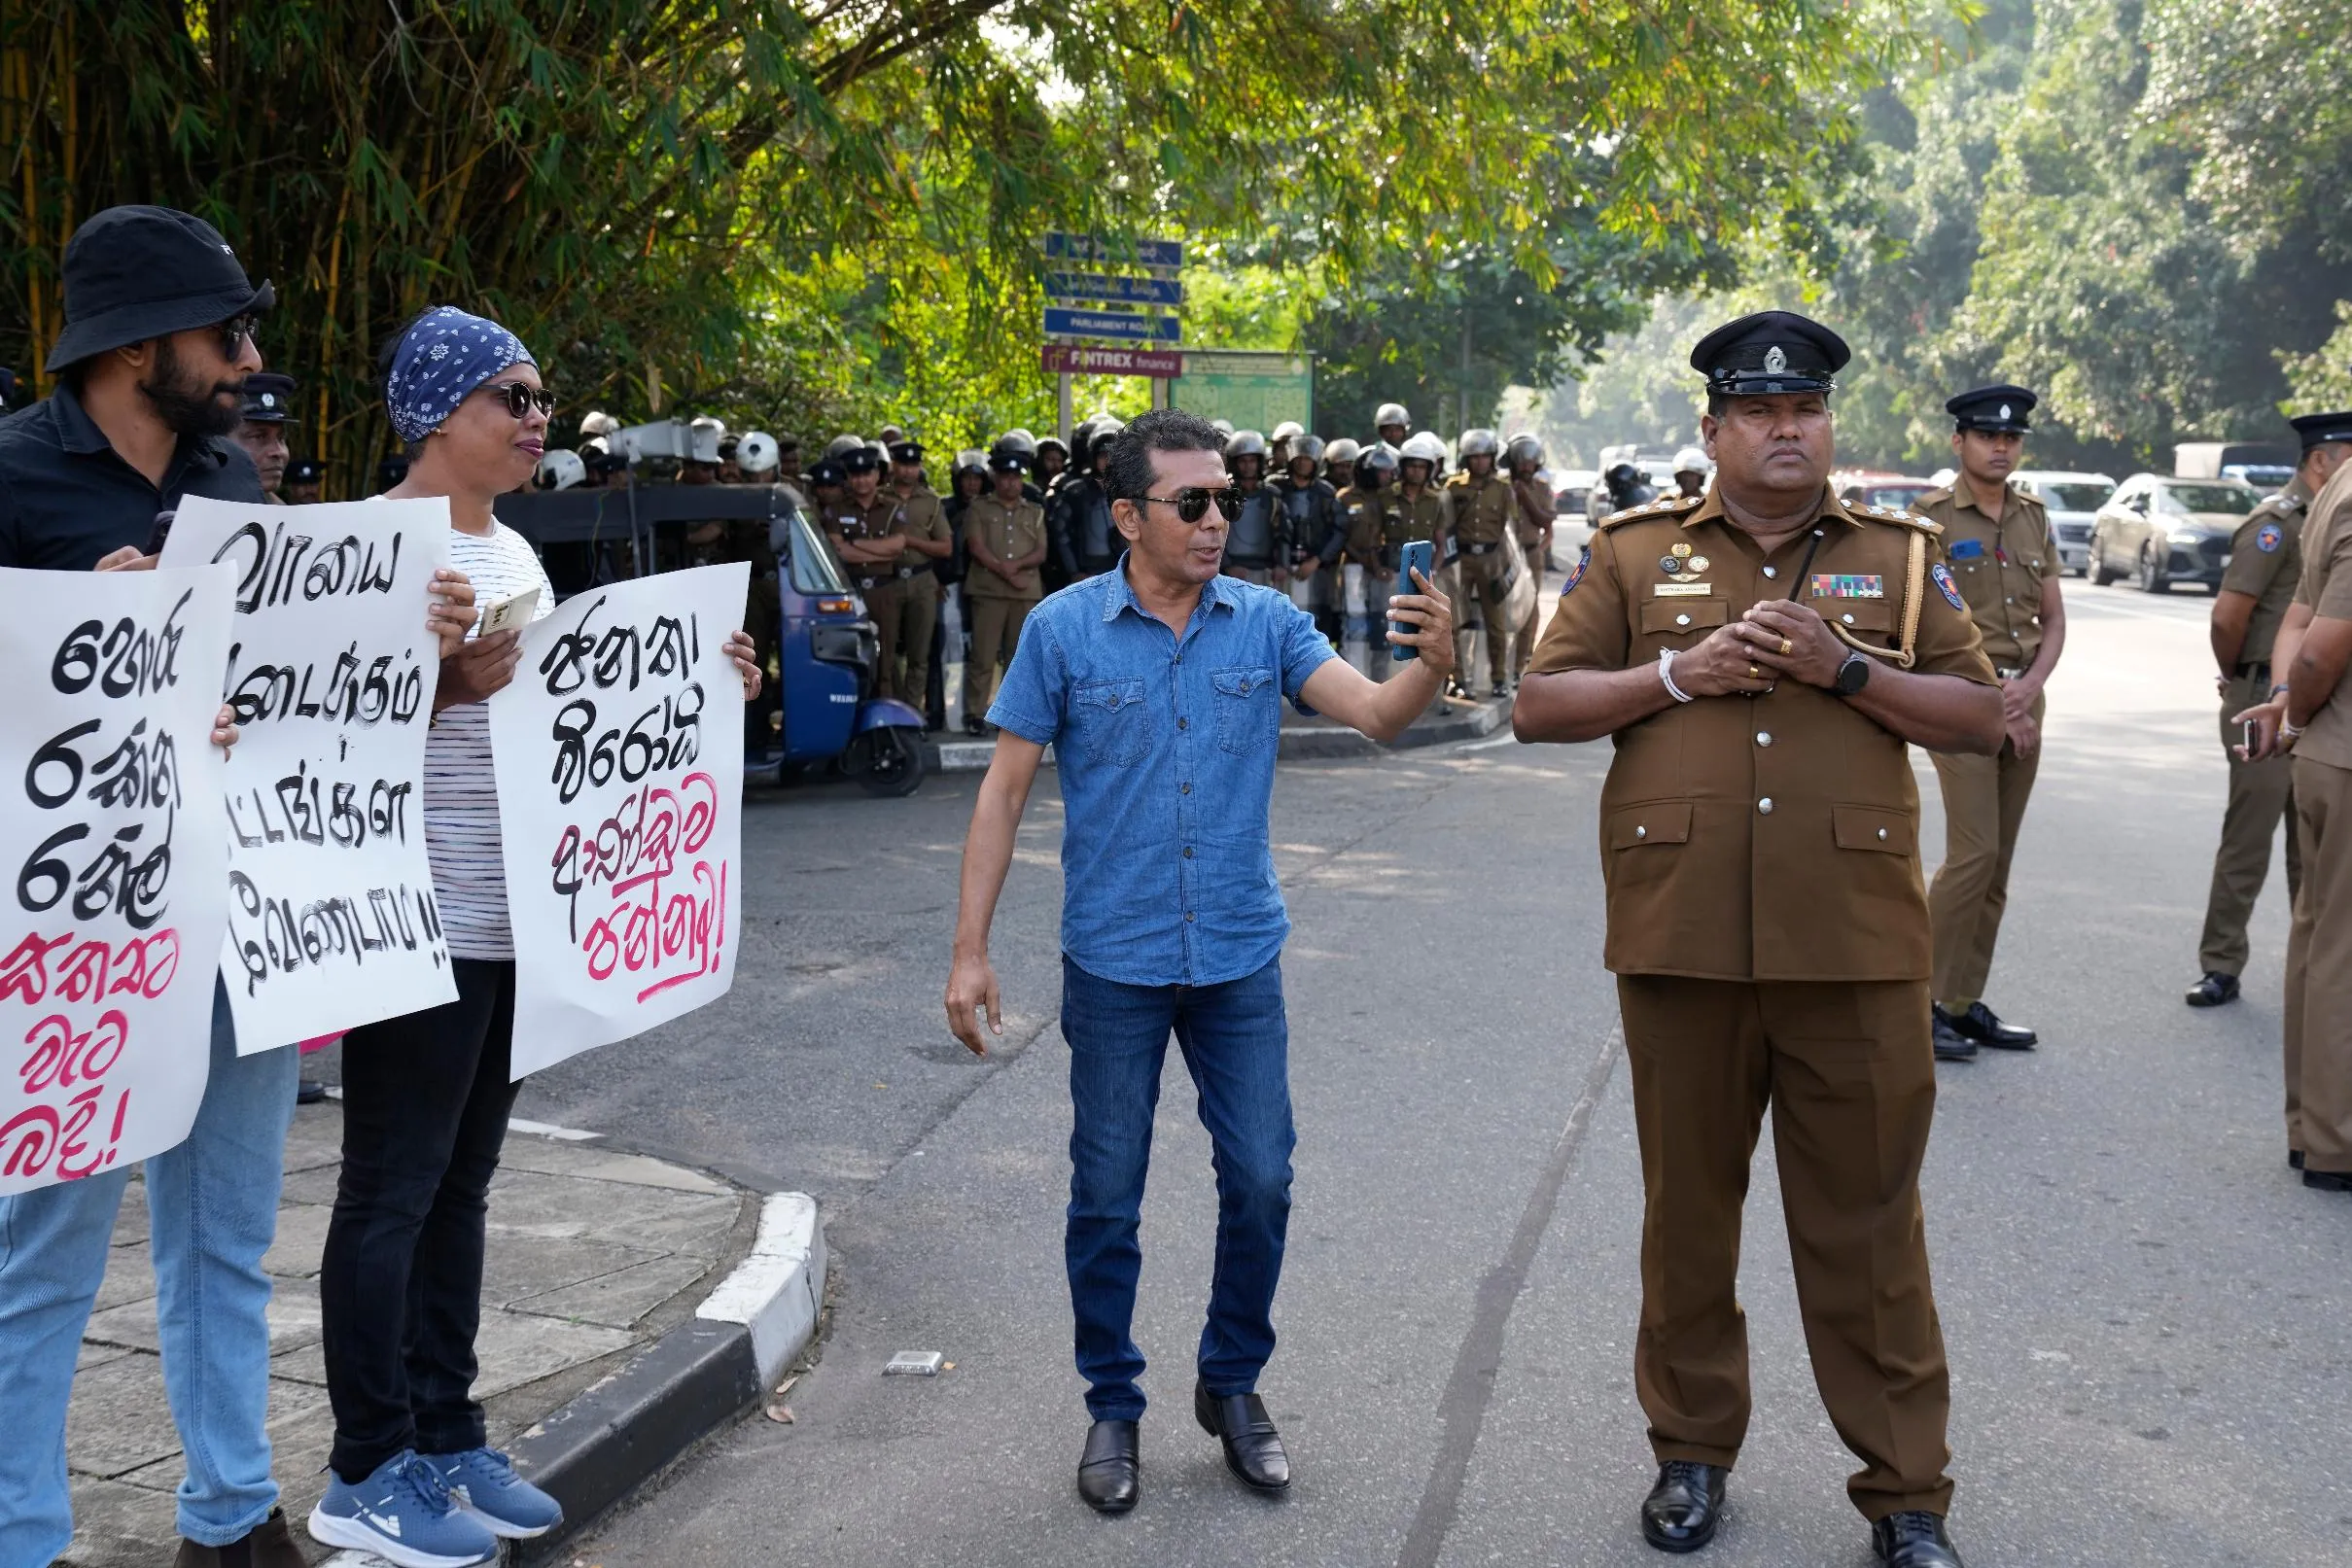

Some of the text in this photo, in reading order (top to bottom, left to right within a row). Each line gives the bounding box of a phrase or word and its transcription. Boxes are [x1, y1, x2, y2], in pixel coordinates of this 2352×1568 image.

[1071, 351, 1132, 368] FNTREX
[1137, 356, 1176, 370] finance
[223, 638, 423, 731] டைக்கும்
